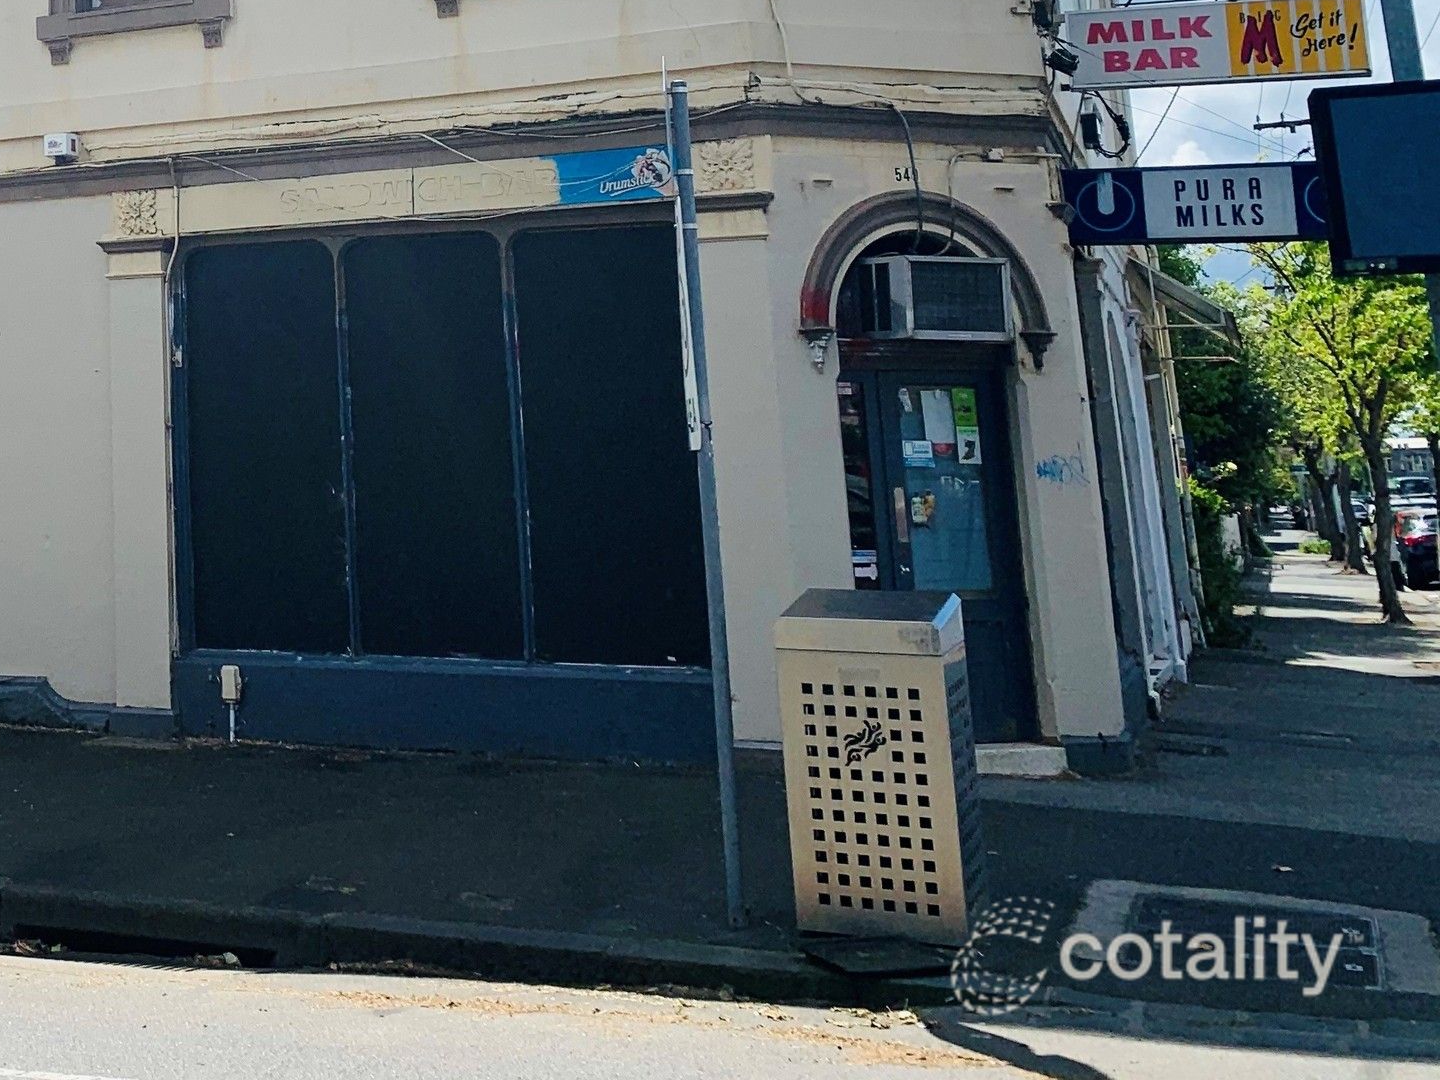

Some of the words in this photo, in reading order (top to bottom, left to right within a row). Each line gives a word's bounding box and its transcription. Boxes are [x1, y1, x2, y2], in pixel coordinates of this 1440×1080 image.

[1087, 15, 1213, 45] MILK
[1290, 11, 1324, 38] Get
[1329, 8, 1343, 28] it
[1302, 22, 1358, 57] Here!
[1103, 46, 1200, 73] BAR
[1173, 177, 1262, 201] PURA
[1175, 203, 1264, 227] MILKS
